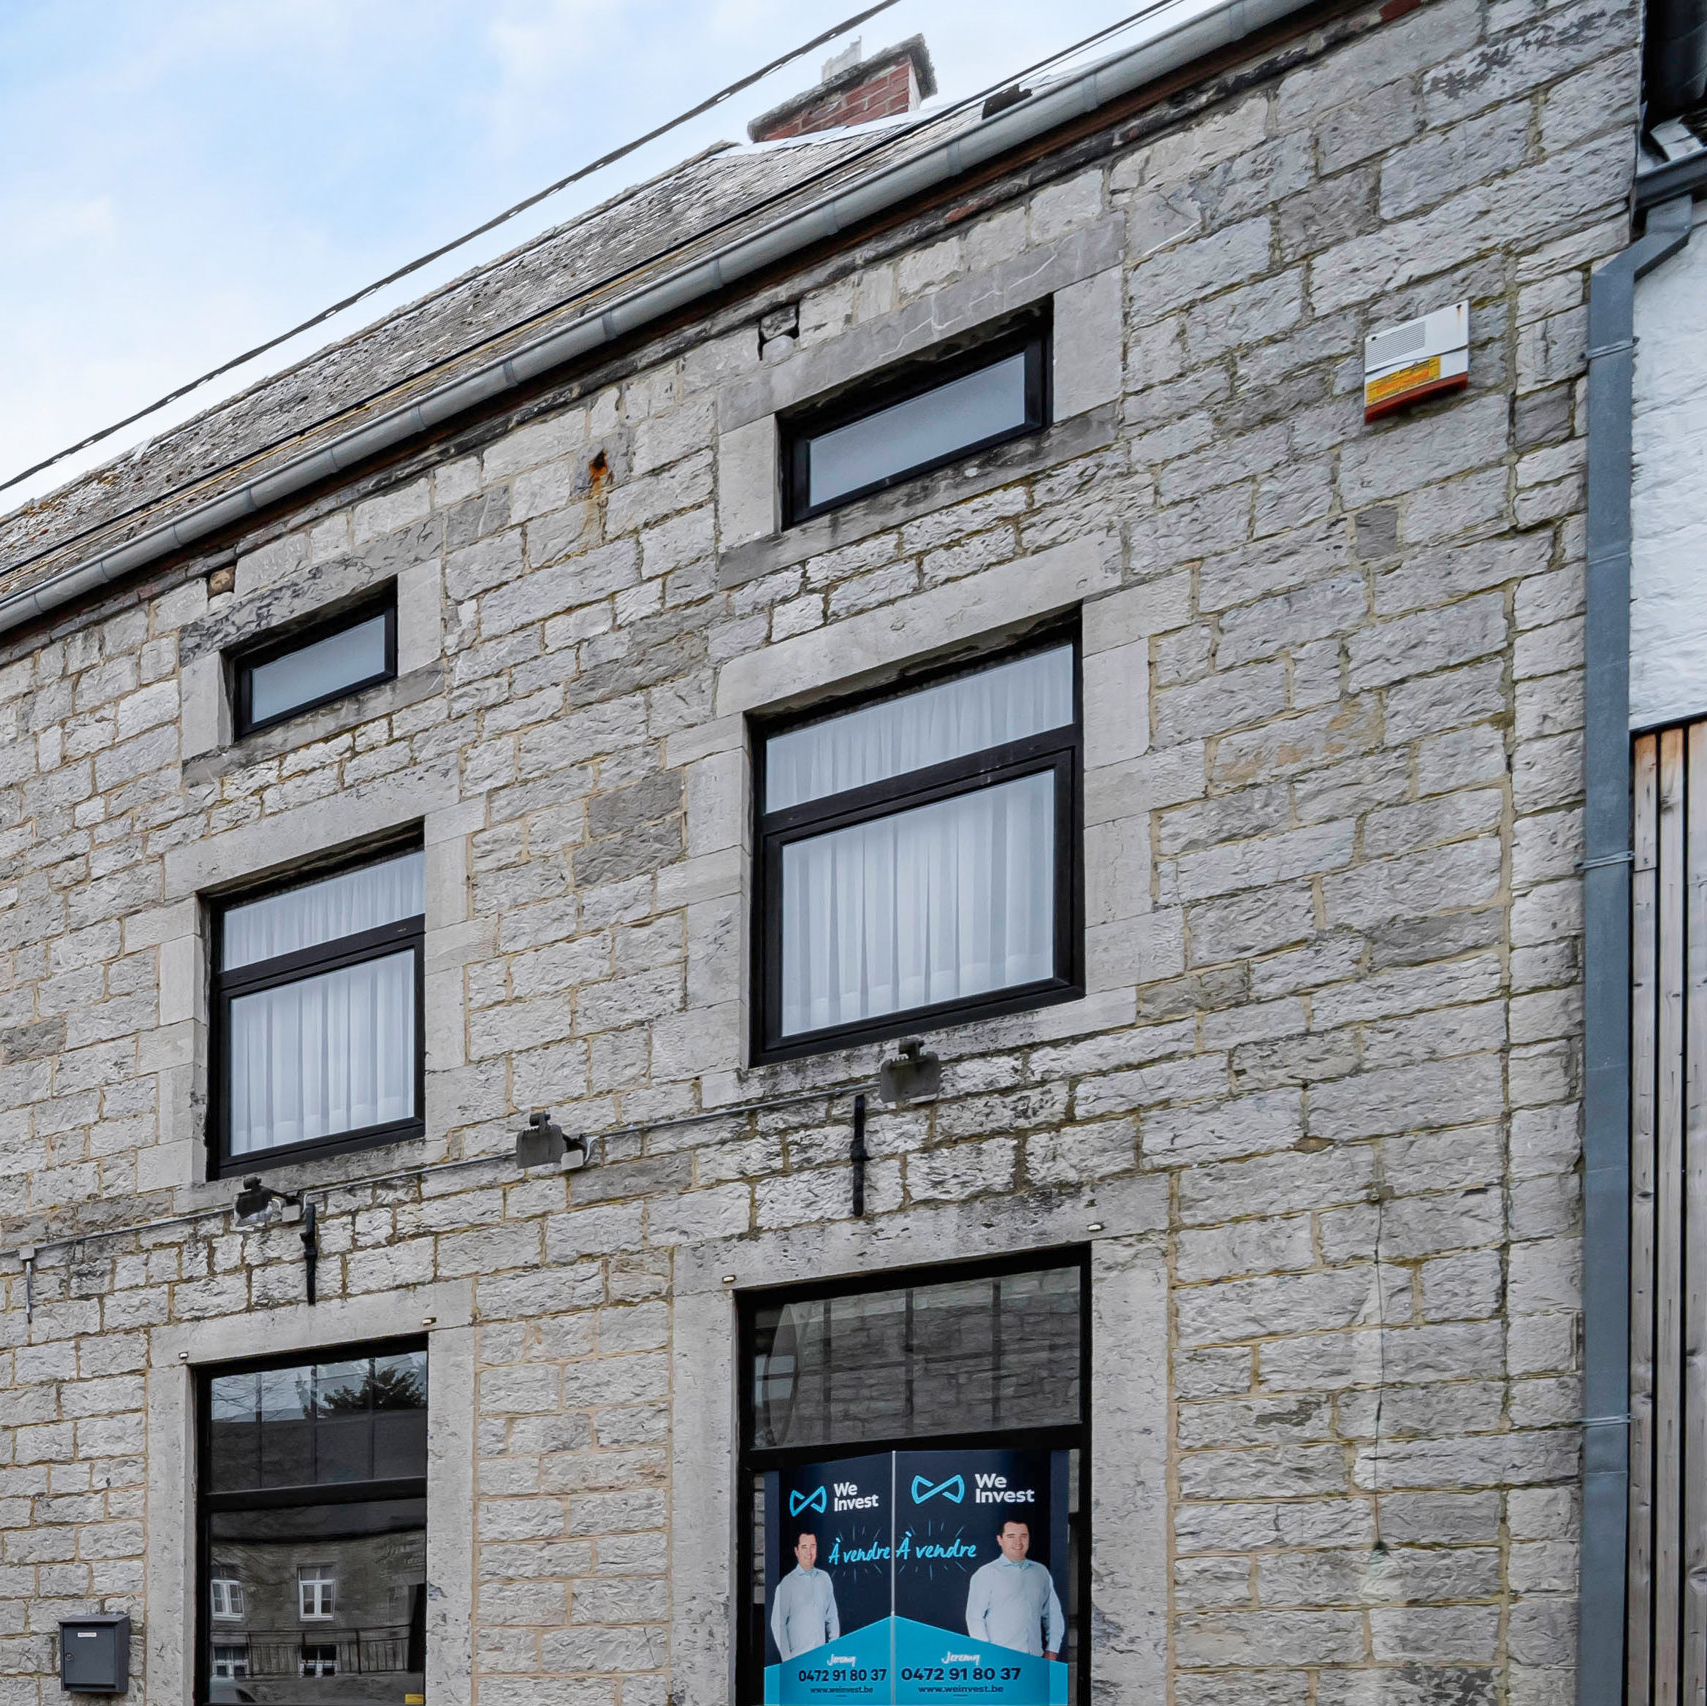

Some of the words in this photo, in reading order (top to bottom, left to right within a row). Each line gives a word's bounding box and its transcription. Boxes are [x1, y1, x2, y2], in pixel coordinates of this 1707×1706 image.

[975, 1473, 1007, 1488] We
[834, 1482, 858, 1497] We
[975, 1489, 1035, 1503] Invest
[834, 1494, 879, 1512] Invest
[829, 1537, 841, 1565] À
[843, 1541, 891, 1563] vendre
[896, 1531, 912, 1560] À
[915, 1538, 977, 1558] vendre
[798, 1669, 829, 1682] 0472
[832, 1669, 847, 1681] 91
[850, 1669, 867, 1681] 80
[870, 1668, 887, 1681] 37
[901, 1668, 944, 1680] 0472
[948, 1668, 968, 1680] 91
[972, 1668, 996, 1680] 80
[1000, 1668, 1022, 1680] 37
[918, 1685, 1004, 1693] www.weinvest.be
